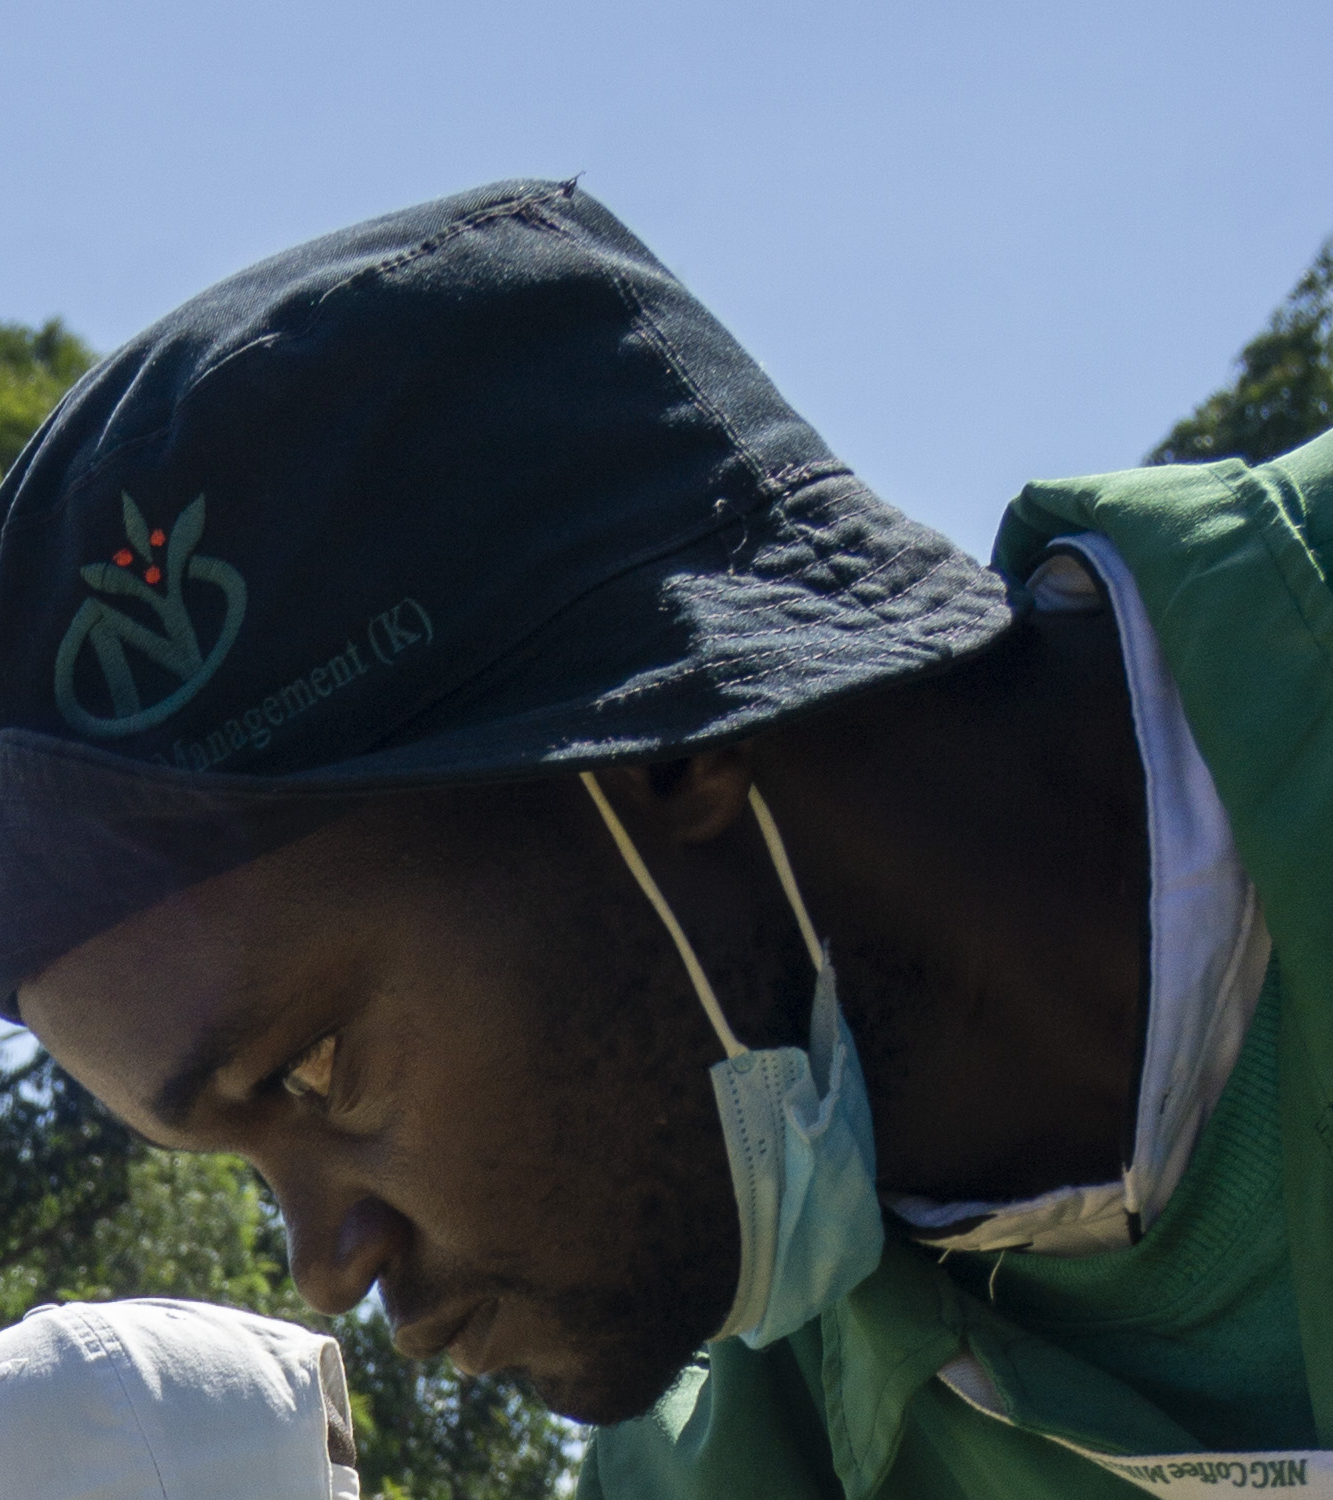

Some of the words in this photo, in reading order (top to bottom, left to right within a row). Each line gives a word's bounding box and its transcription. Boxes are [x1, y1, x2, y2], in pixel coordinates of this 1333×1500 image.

[367, 598, 434, 665] (K)
[1167, 1461, 1247, 1488] Coffee
[1251, 1460, 1307, 1489] NKG
